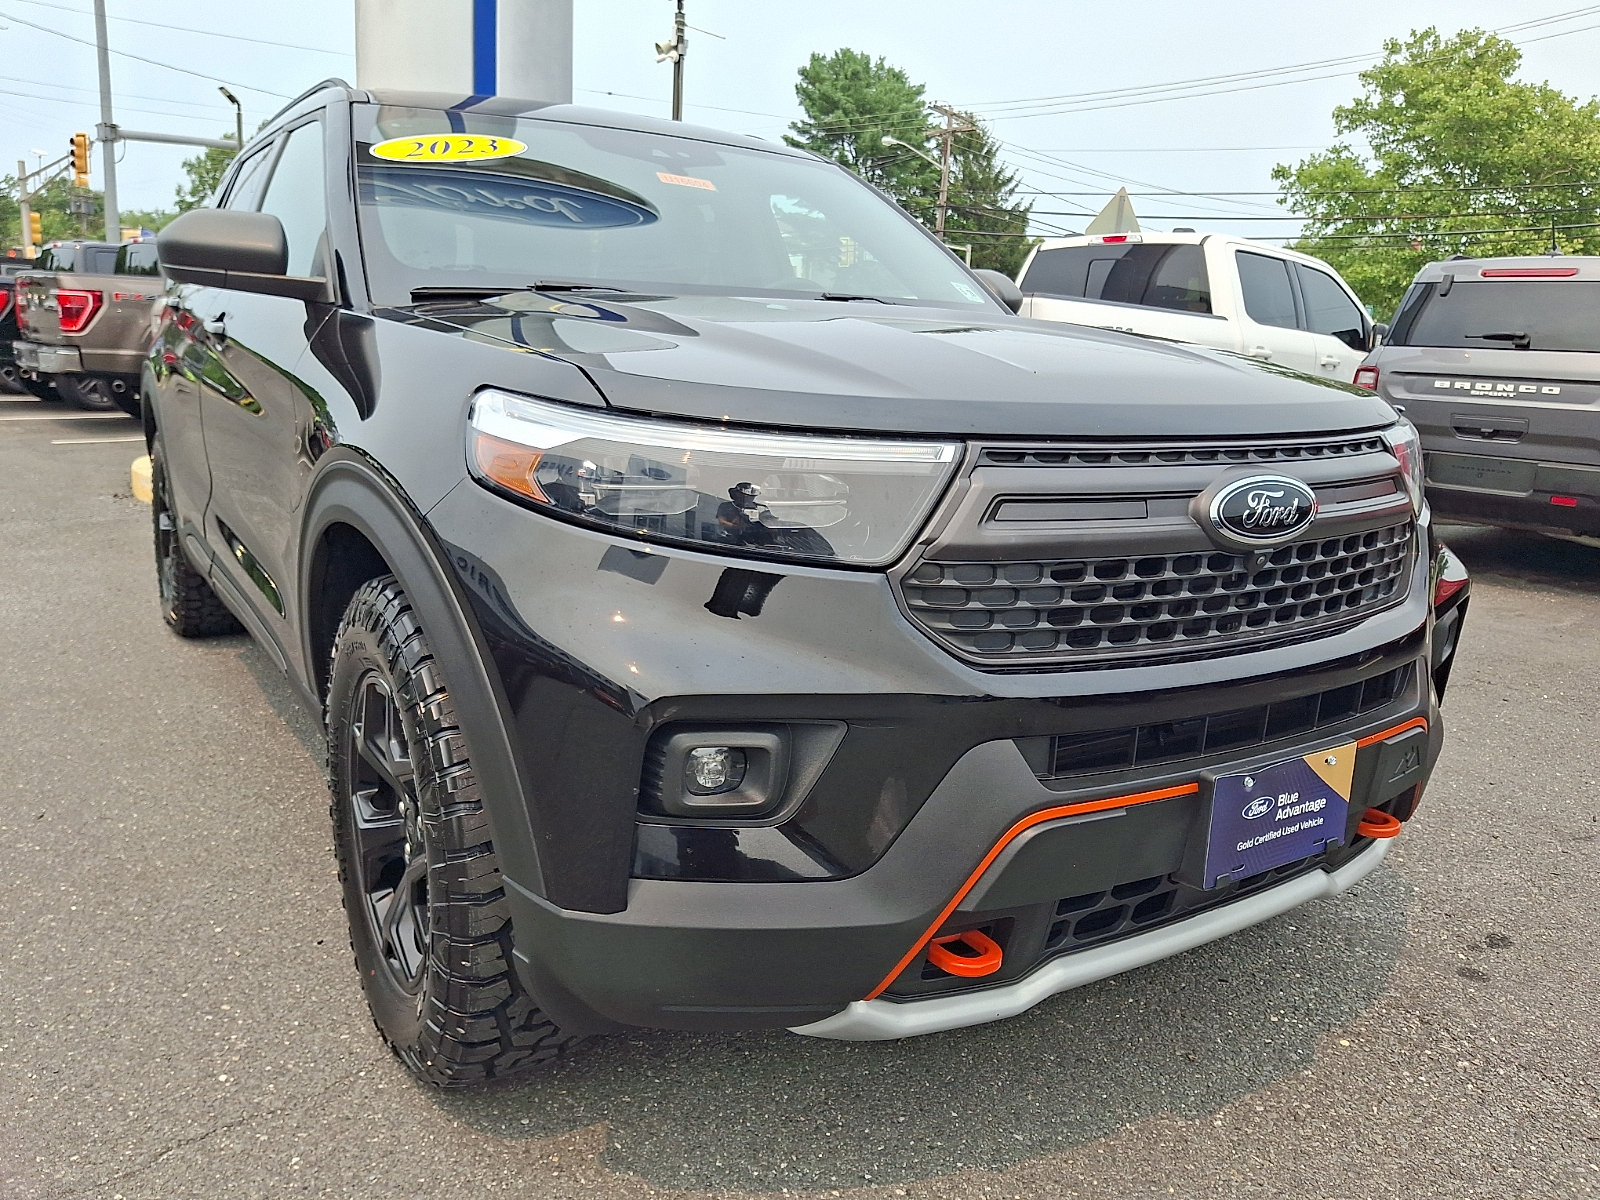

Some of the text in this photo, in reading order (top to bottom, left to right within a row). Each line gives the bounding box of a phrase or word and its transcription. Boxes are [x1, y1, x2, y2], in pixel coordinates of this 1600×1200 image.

[406, 139, 498, 157] 2023
[1434, 380, 1561, 395] BRONCO
[1470, 389, 1517, 398] SPORT
[1242, 490, 1299, 529] Ford
[1277, 792, 1299, 807] Blue
[1275, 798, 1327, 822] Advantage
[1236, 816, 1324, 851] Gold Certified Used Vehicle
